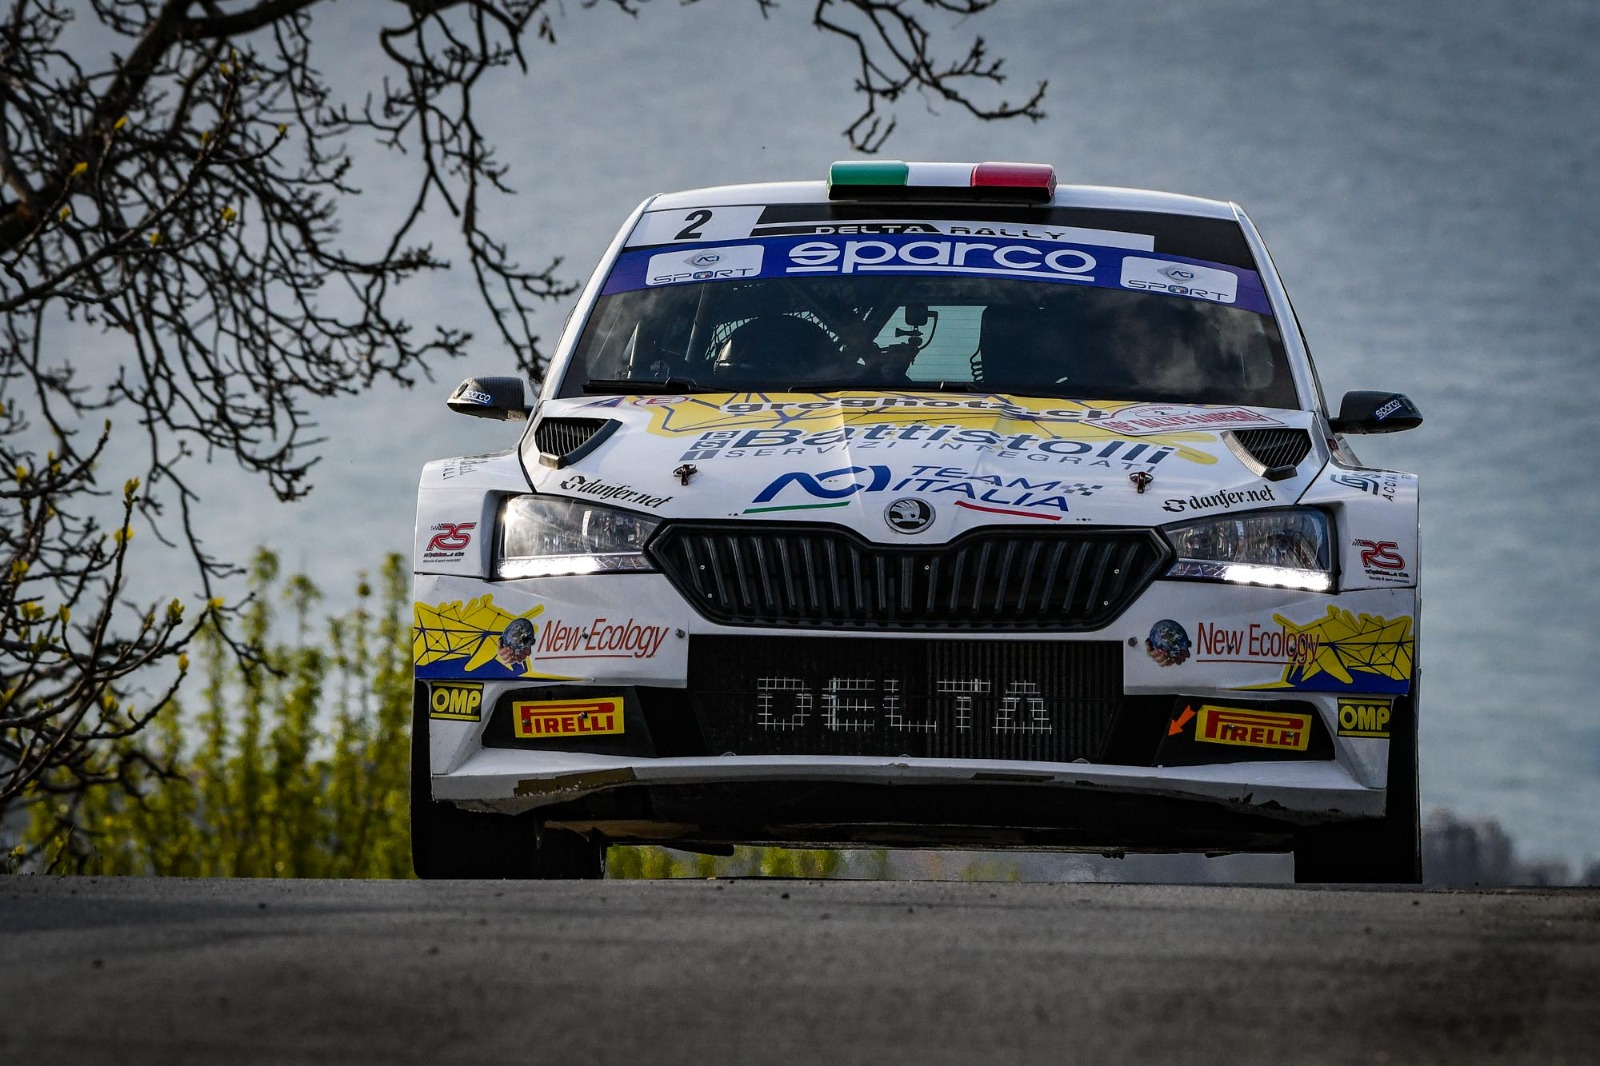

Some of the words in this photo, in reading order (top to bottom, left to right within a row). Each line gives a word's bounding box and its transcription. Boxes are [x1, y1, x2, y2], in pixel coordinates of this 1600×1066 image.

[674, 209, 713, 241] 2
[815, 225, 925, 235] DELTA
[950, 226, 1067, 240] RALLY
[786, 240, 1097, 276] sparco
[652, 267, 754, 285] SPORT
[1127, 279, 1229, 301] SPORT
[1375, 399, 1402, 419] sparco
[724, 441, 897, 458] SERVIZI
[921, 442, 1156, 473] INTEGRATI
[731, 424, 1175, 465] Battistolli
[577, 479, 674, 508] danfer.net
[912, 465, 1062, 491] TEAM
[892, 478, 1069, 512] ITALIA
[1189, 485, 1276, 511] danfer.net
[537, 619, 583, 653] New
[584, 618, 669, 659] Ecology
[1197, 622, 1244, 657] New
[1249, 624, 1320, 665] Ecology
[431, 689, 482, 714] OMP
[757, 677, 1052, 735] DELTA
[521, 702, 616, 734] PIRELLI
[1204, 710, 1304, 747] PIRELLI
[1339, 705, 1390, 731] OMP
